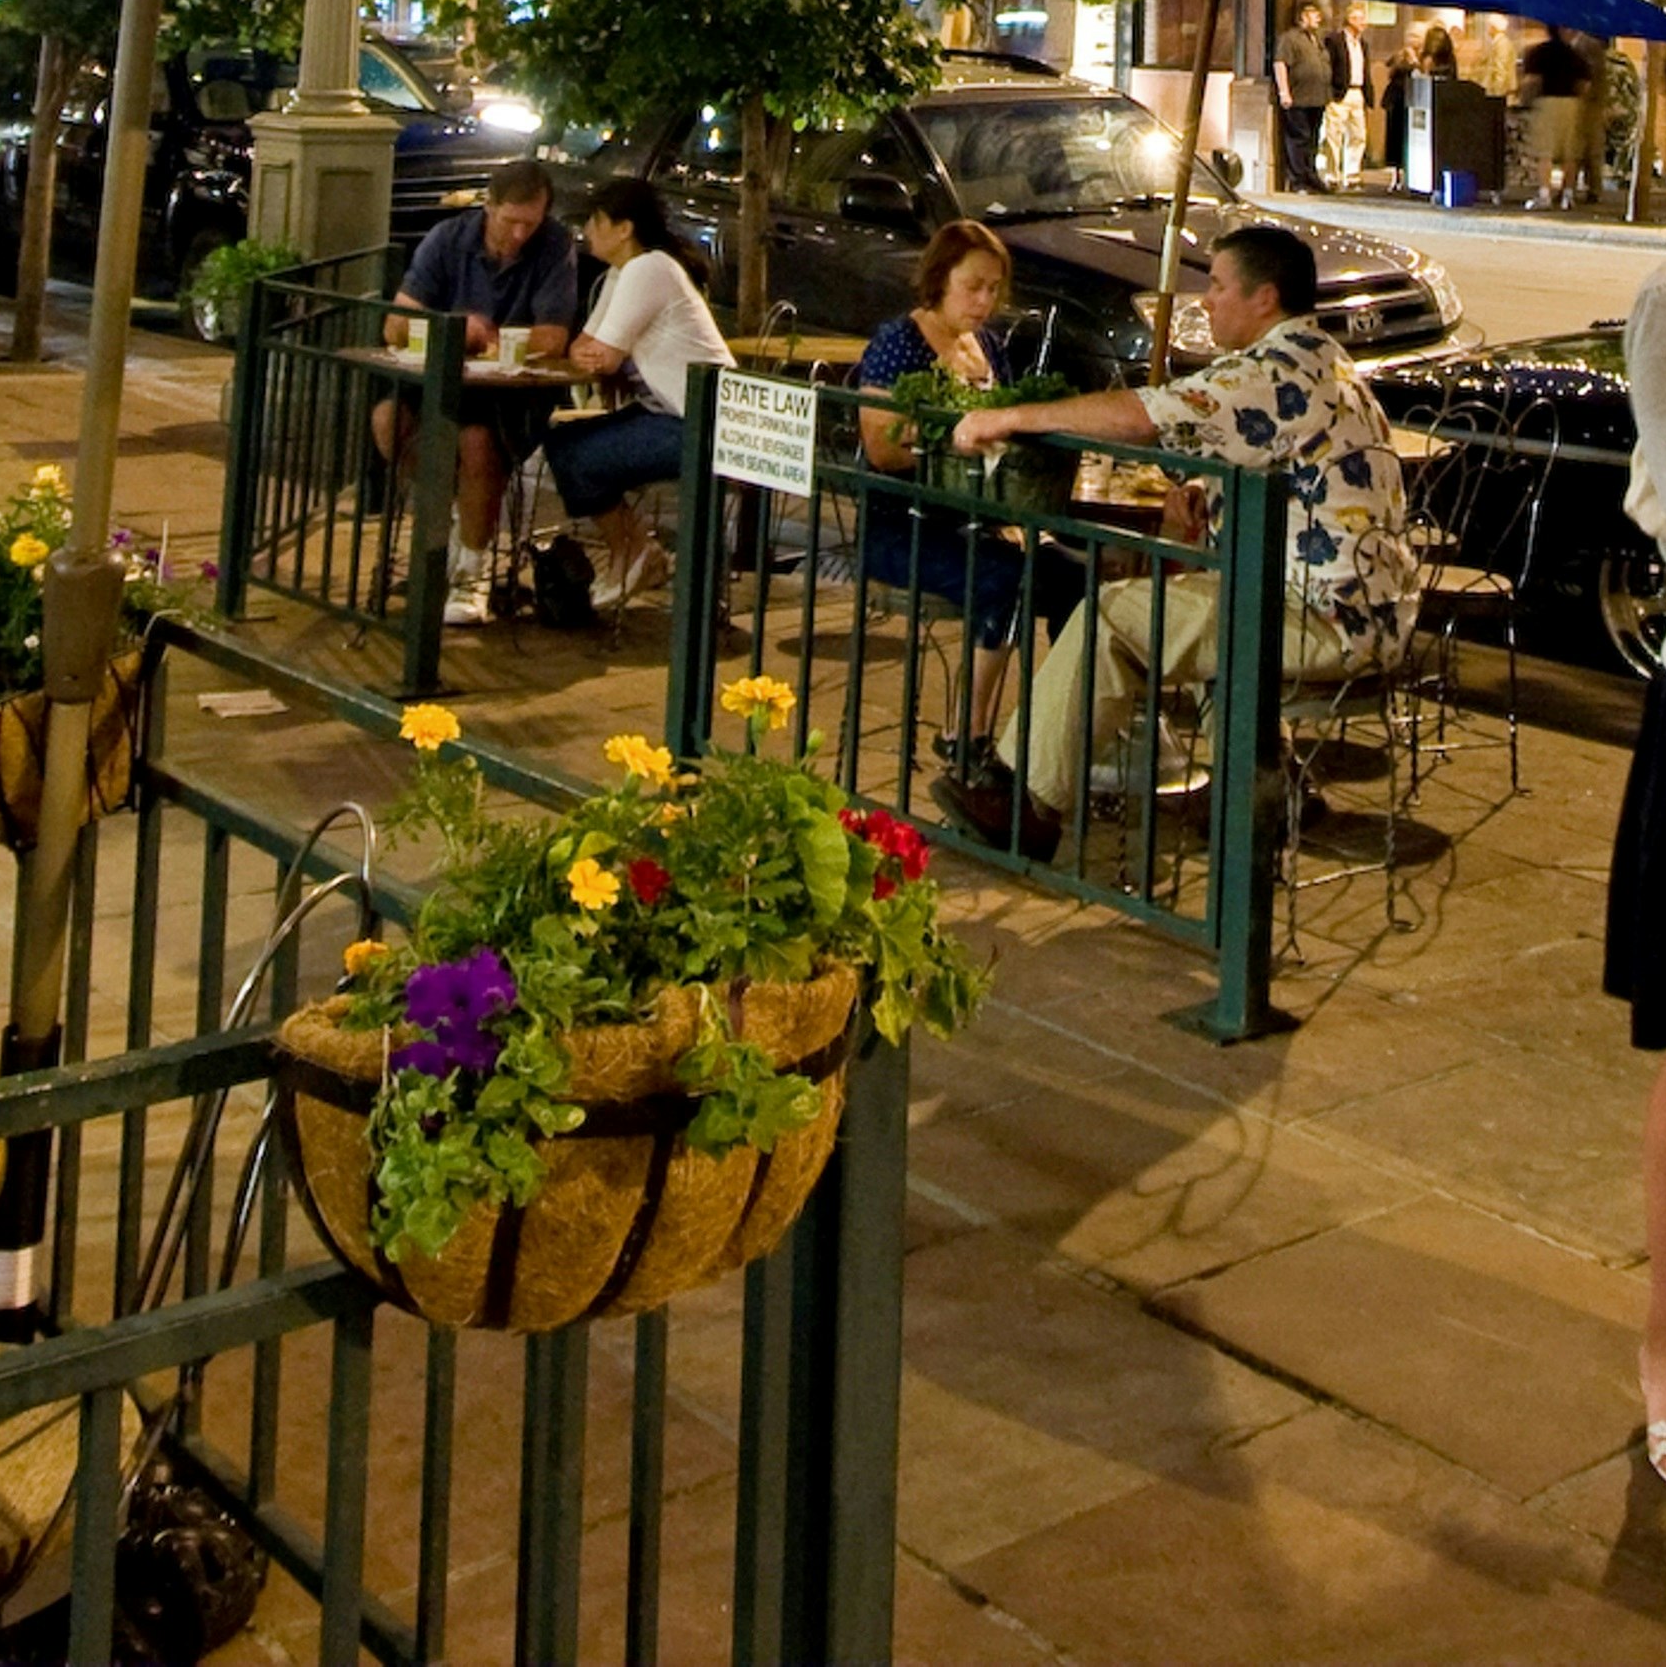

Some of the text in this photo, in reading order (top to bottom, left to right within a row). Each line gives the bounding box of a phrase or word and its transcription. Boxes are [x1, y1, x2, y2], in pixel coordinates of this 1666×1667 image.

[720, 378, 812, 420] STATE LAW
[727, 448, 745, 469] THIS
[746, 453, 781, 478] SEATING
